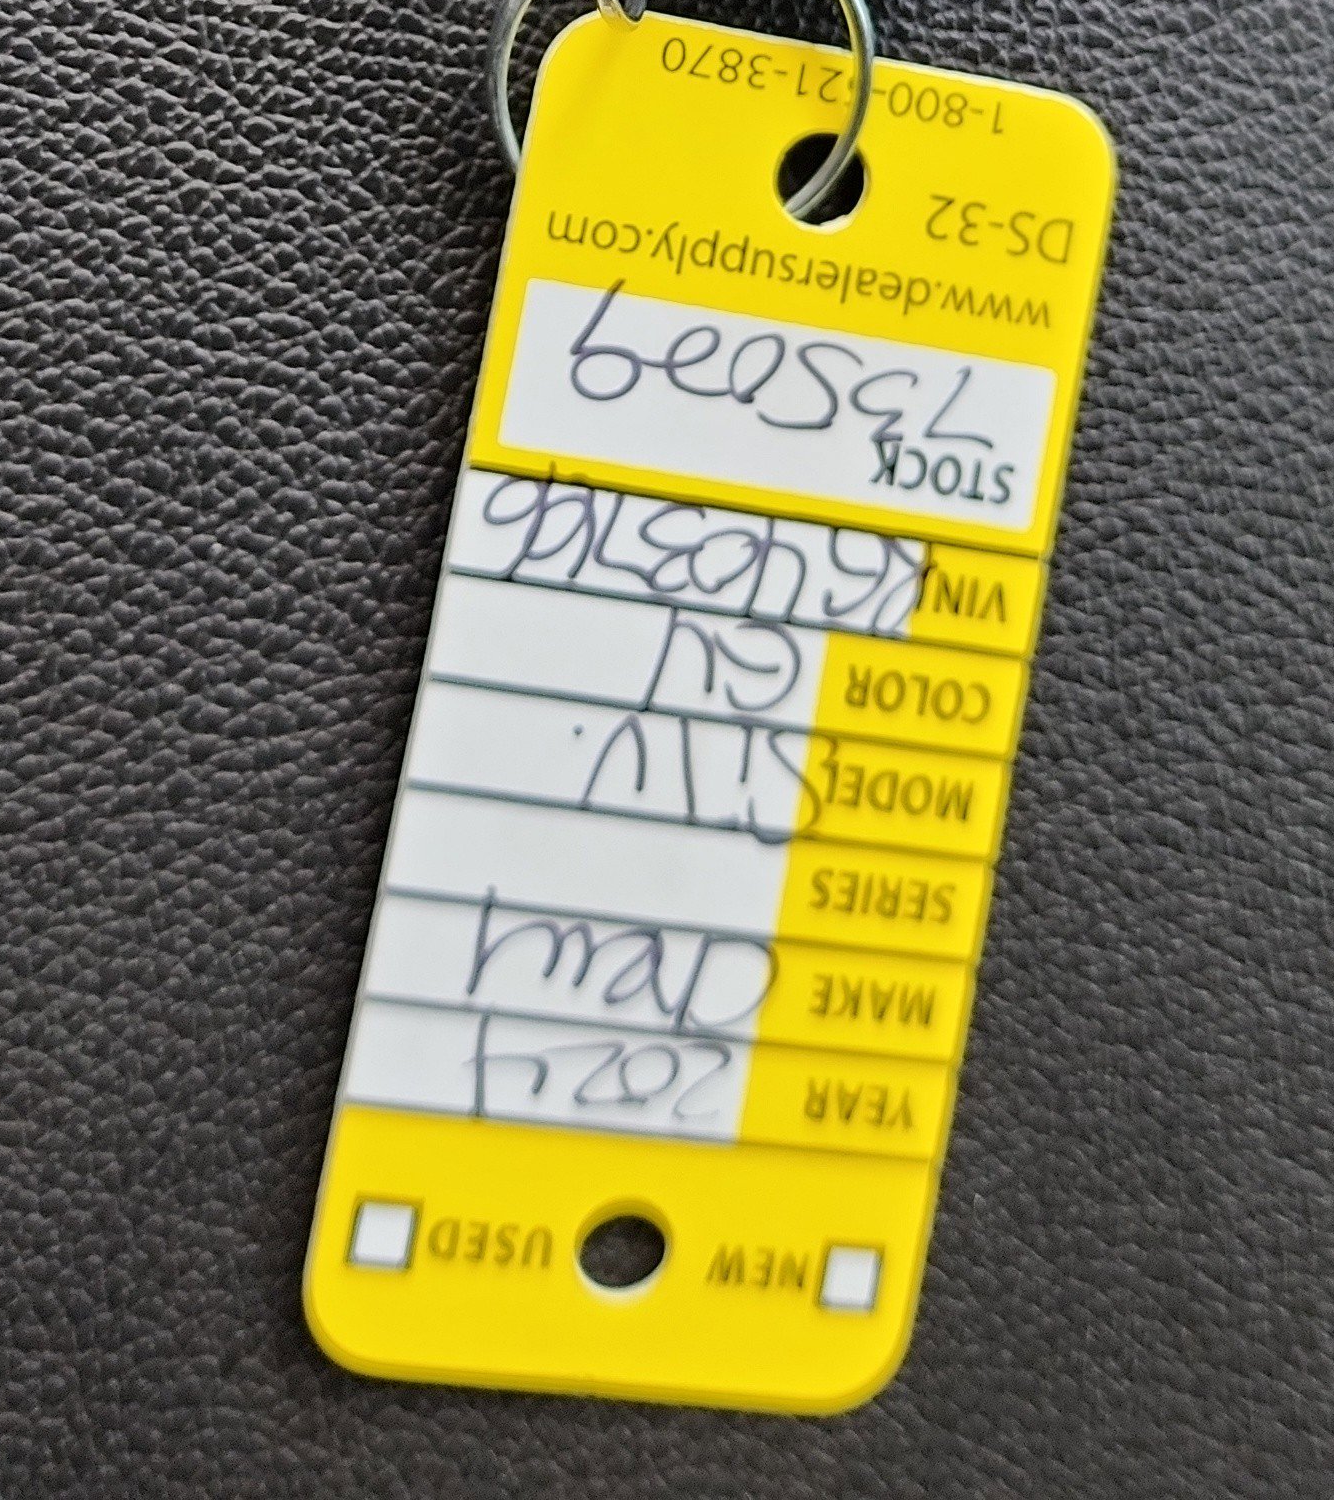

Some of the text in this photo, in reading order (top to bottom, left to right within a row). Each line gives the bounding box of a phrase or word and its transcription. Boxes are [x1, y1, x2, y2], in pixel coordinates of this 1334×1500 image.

[925, 194, 1075, 266] DS-32
[546, 210, 1052, 332] www.dealersupply.com
[569, 279, 994, 450] 735029
[870, 442, 1015, 504] STOCK
[931, 579, 1007, 624] VIN
[846, 665, 990, 724] COLOR
[824, 764, 973, 822] MODEL
[807, 868, 955, 925] SERIES
[810, 973, 935, 1029] MAKE
[464, 1013, 731, 1122] 2024
[804, 1079, 913, 1131] YEAR
[428, 1217, 553, 1268] USED
[705, 1244, 810, 1293] NEW
